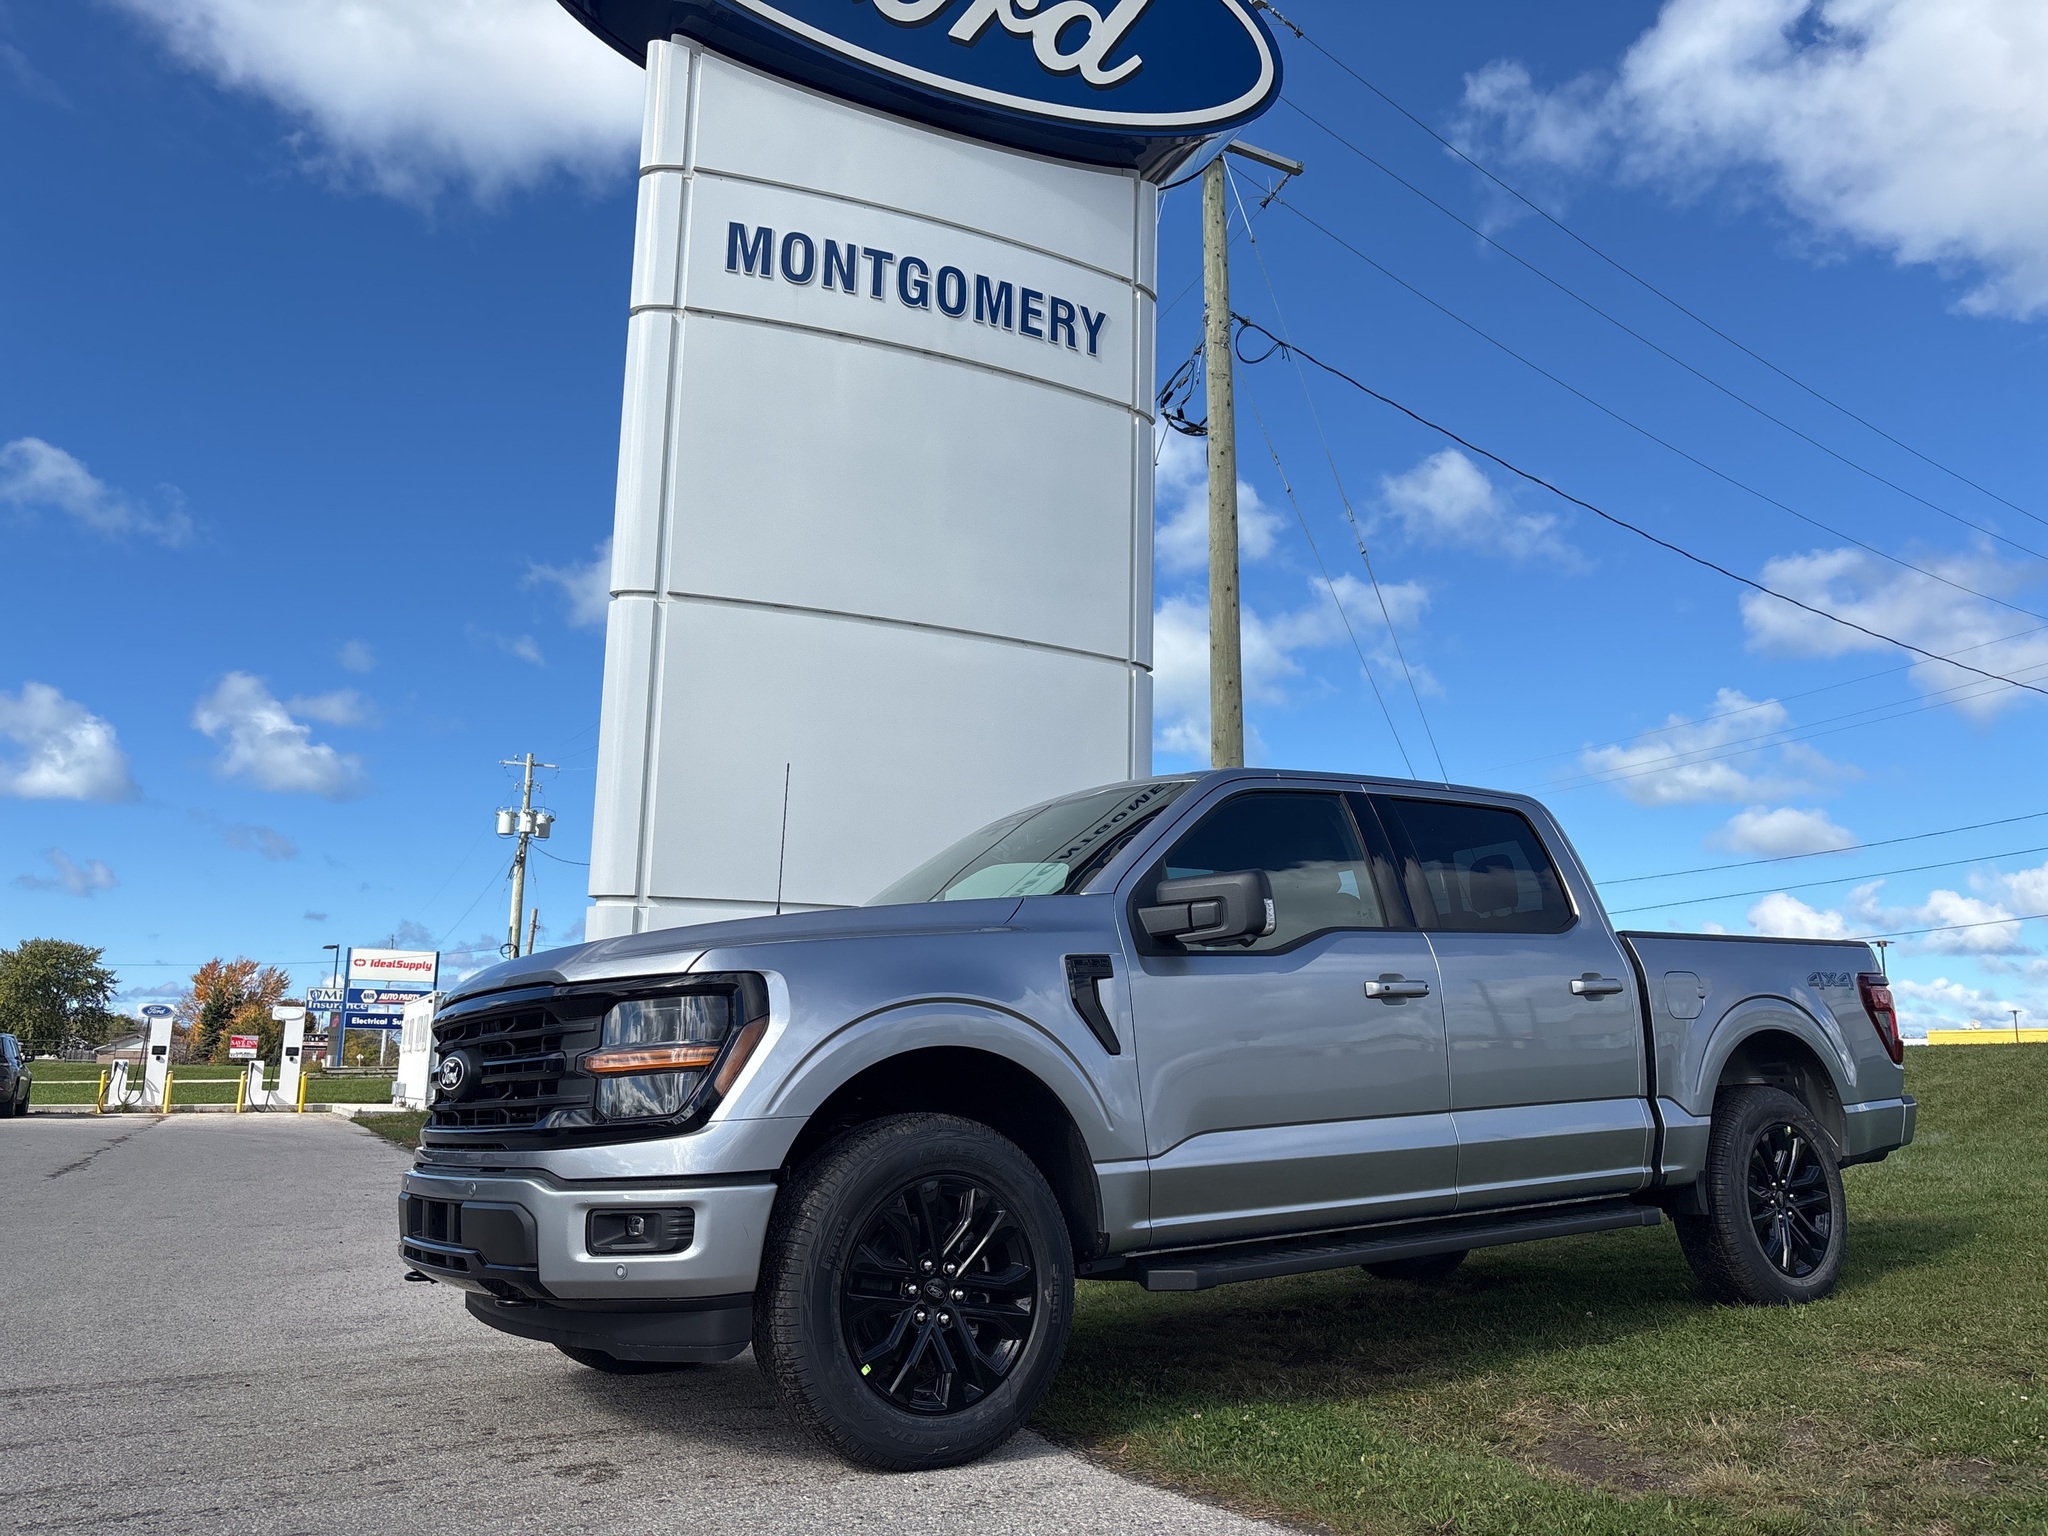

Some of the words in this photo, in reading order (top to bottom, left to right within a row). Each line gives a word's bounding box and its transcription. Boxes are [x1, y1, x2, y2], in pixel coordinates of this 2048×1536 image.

[725, 220, 1107, 358] MONTGOMERY
[370, 959, 433, 971] IdealSupply
[379, 993, 399, 1001] AUTO
[351, 1017, 388, 1025] Electrical
